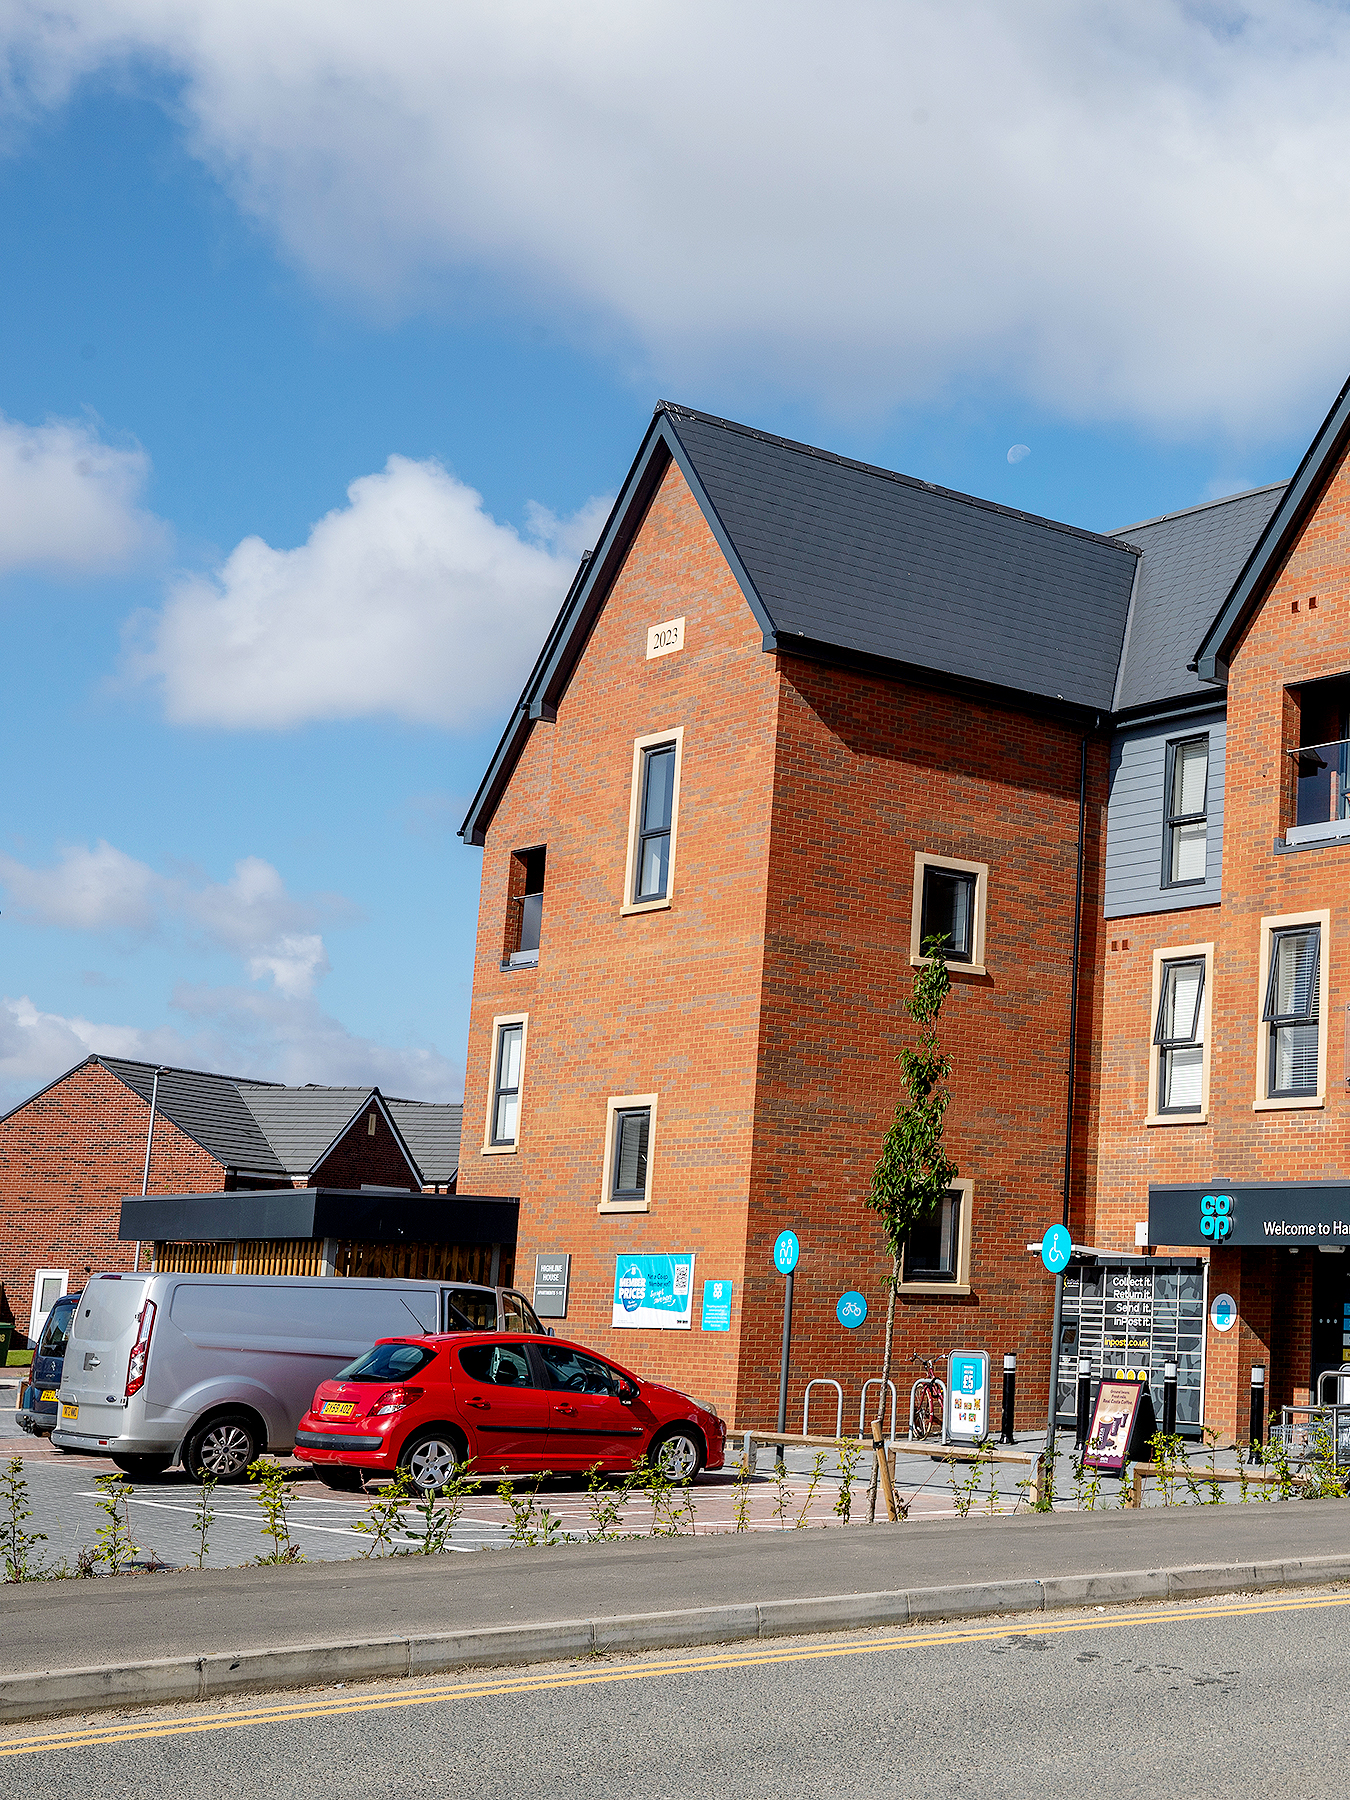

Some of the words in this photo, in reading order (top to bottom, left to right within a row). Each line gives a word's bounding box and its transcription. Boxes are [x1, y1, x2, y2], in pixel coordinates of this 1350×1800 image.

[653, 627, 678, 650] 2023
[1263, 1220, 1317, 1236] Welcome
[1318, 1222, 1331, 1235] to
[541, 1264, 563, 1273] HIGHLINE
[542, 1273, 561, 1282] HOUSE
[1112, 1277, 1144, 1287] Collect
[1144, 1277, 1152, 1287] it.
[619, 1278, 647, 1288] MEMBER
[618, 1288, 646, 1300] PRICES
[1113, 1289, 1143, 1299] Return
[1116, 1303, 1139, 1313] Send
[1142, 1303, 1151, 1313] it.
[1113, 1317, 1142, 1327] InPost
[1142, 1318, 1151, 1327] it.
[1104, 1337, 1149, 1348] inpost.co.uk
[963, 1374, 974, 1390] £5
